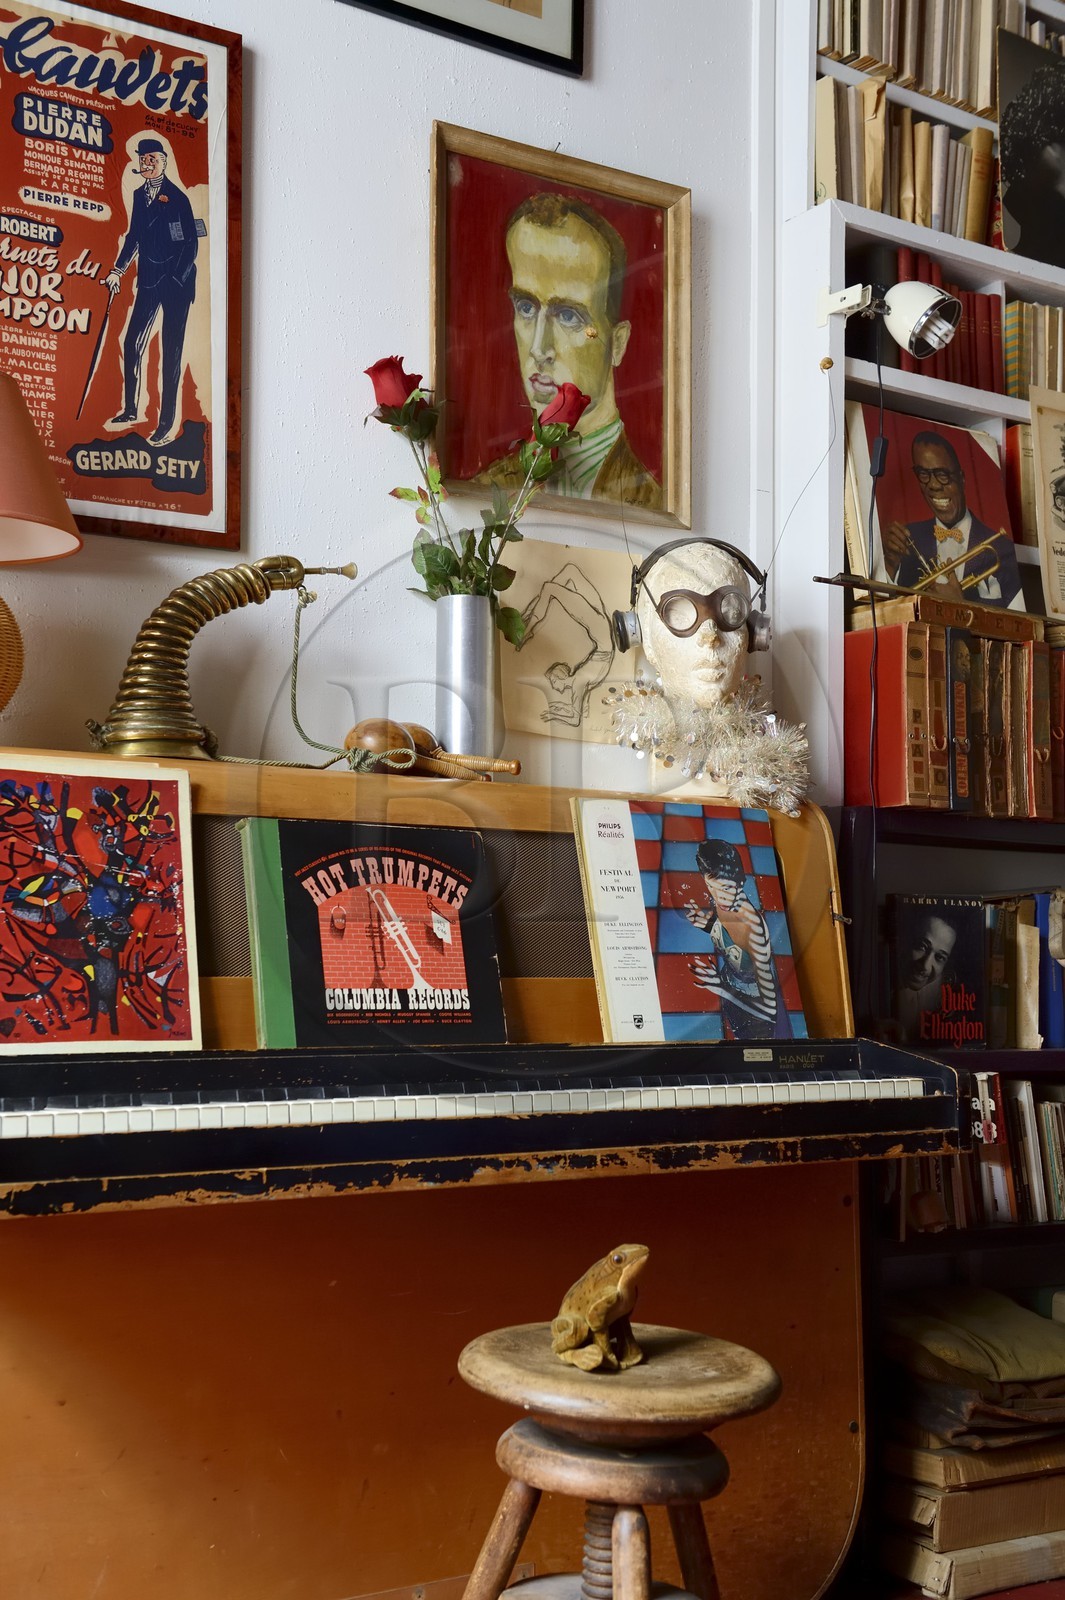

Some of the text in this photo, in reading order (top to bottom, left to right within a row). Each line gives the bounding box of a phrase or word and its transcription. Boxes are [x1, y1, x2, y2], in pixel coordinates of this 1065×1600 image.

[23, 96, 102, 126] PIERRE
[23, 110, 103, 147] DUDAN
[24, 137, 105, 165] BORIS VIAN
[24, 149, 104, 174] MONIQUE SENATOR
[24, 158, 105, 184] BERNARD REGNIER
[40, 178, 88, 195] KAREN
[92, 182, 105, 190] PAC
[23, 188, 104, 213] PIERRE REPP
[1, 206, 55, 224] SPECTACLE DE
[0, 216, 57, 242] ROBERT
[65, 248, 102, 279] du
[2, 331, 58, 351] DANINOS
[76, 449, 201, 479] GERARD SETY
[597, 830, 625, 839] Réalités
[598, 822, 621, 830] PHILIPS
[301, 856, 470, 912] HOT TRUMPETS
[599, 869, 633, 877] FESTIVAL
[600, 885, 637, 893] NEWPORT
[325, 988, 471, 1011] COLUMBIA RECORDS
[941, 982, 977, 1014] Duke
[920, 1009, 985, 1050] Ellington
